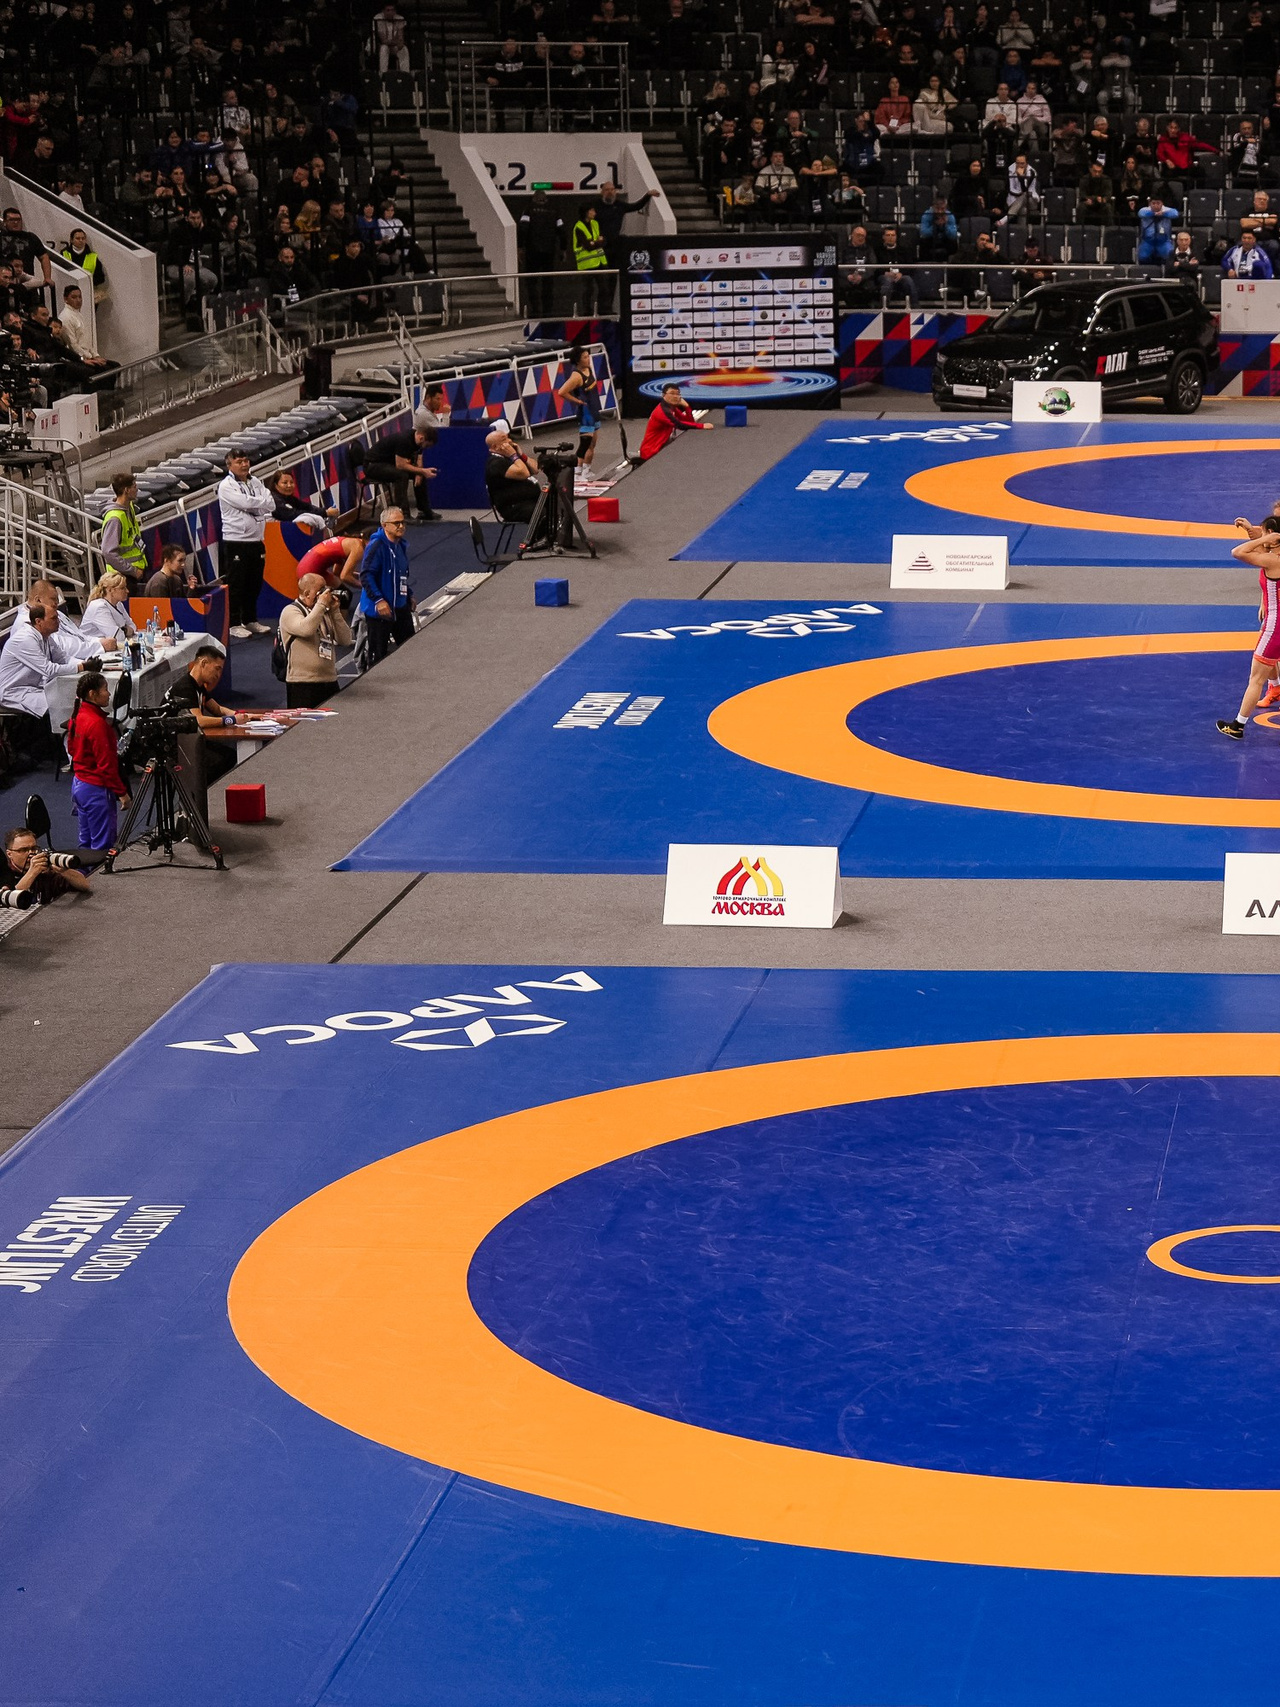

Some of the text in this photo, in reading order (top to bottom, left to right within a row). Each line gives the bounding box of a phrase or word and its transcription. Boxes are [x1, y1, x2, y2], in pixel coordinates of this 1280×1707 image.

[1105, 351, 1128, 374] АГАТ
[616, 603, 883, 639] АЛРОСА
[711, 901, 785, 916] МОСКВА
[165, 970, 604, 1055] АЛРОСА
[70, 1204, 186, 1282] UNITED WORLD
